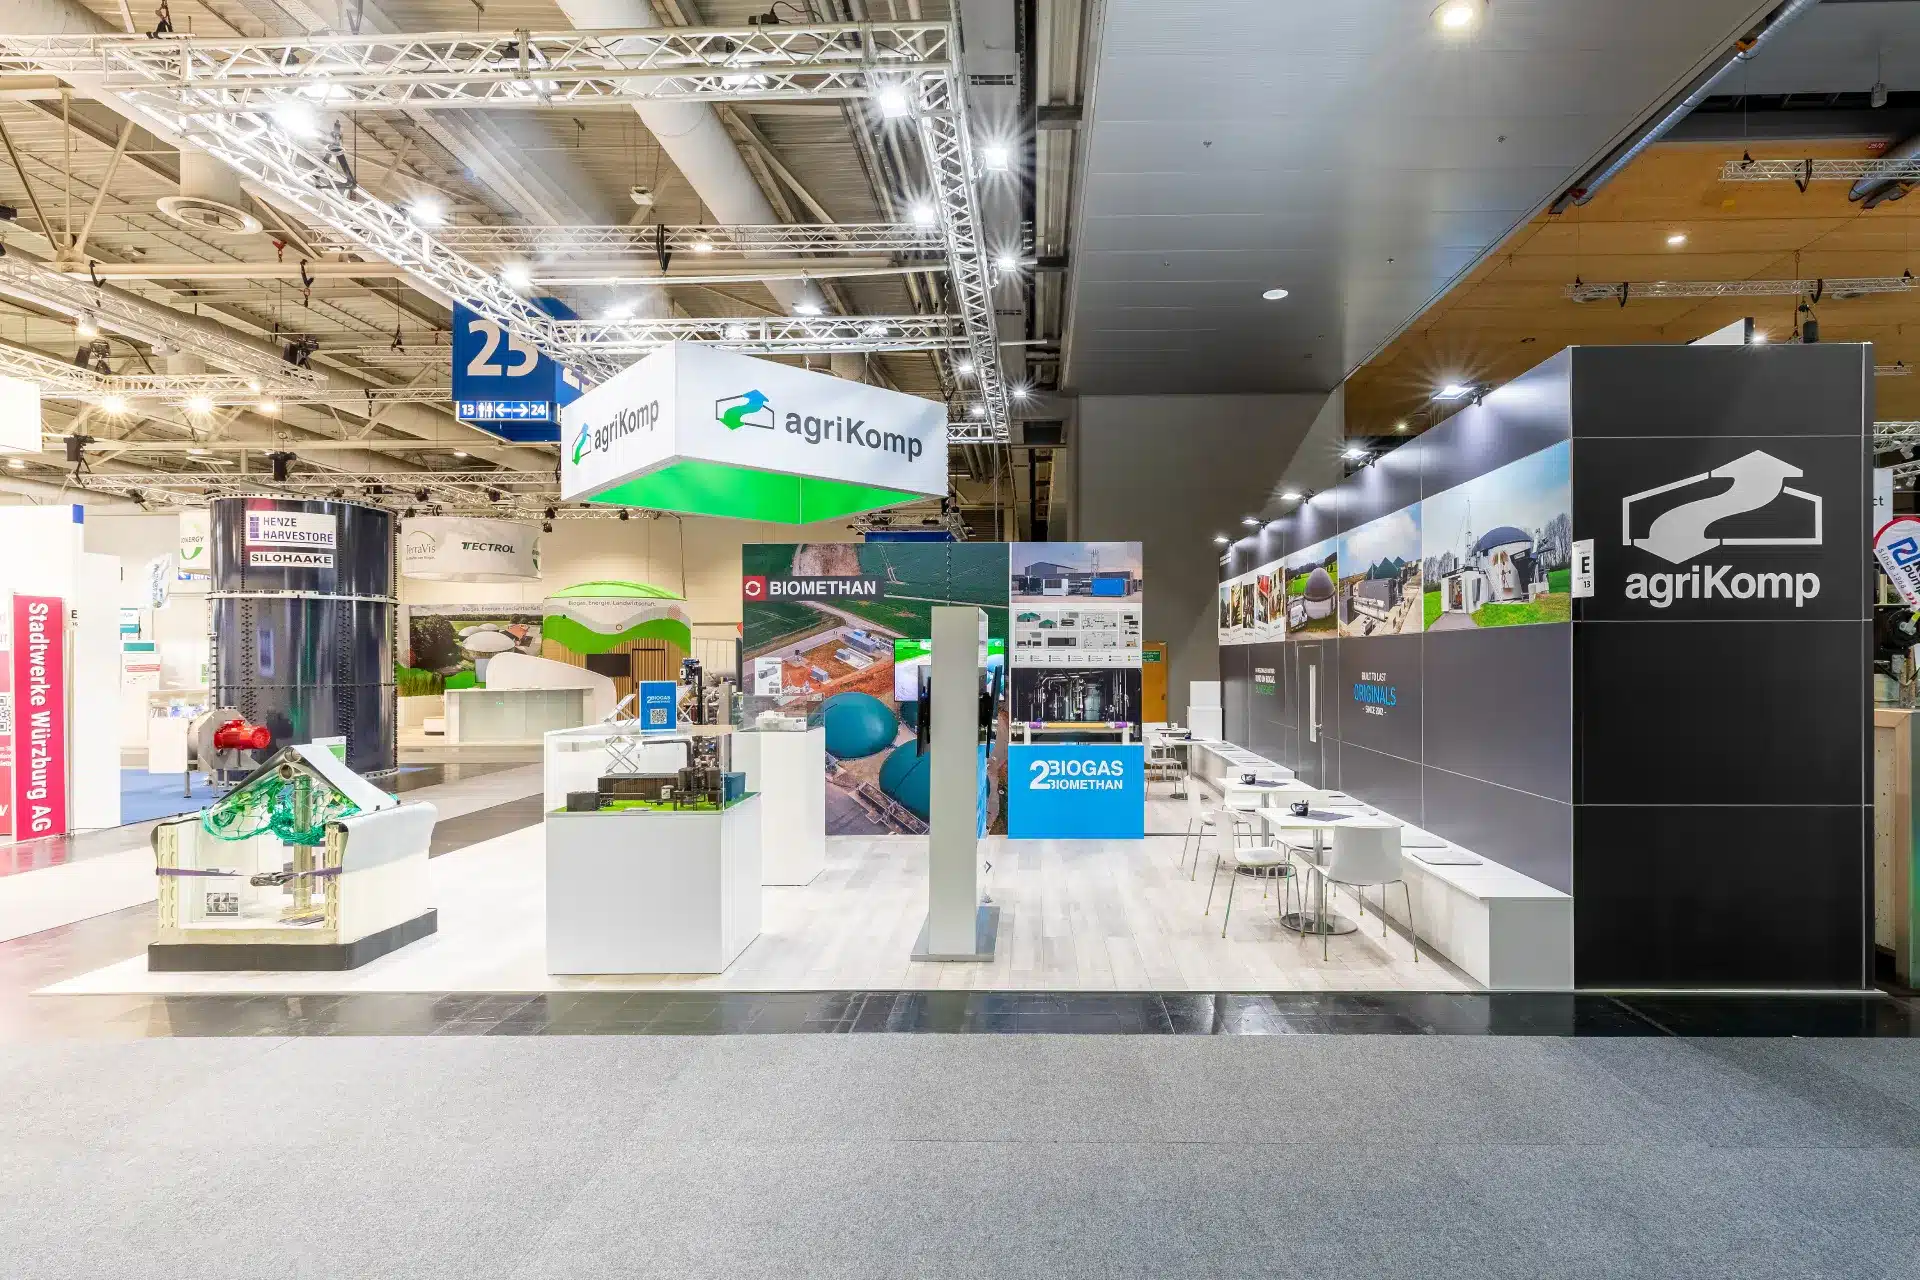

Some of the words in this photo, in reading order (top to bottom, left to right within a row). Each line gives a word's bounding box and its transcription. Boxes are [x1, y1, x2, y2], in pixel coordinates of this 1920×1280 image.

[467, 319, 539, 377] 25
[461, 404, 475, 416] 13
[530, 404, 546, 416] 24
[594, 400, 659, 453] agriKomp
[785, 412, 923, 463] agriKomp
[263, 516, 297, 527] HENZE
[263, 530, 334, 543] HARVESTORE
[406, 543, 436, 555] TerraVis
[461, 541, 516, 554] TECTROL
[251, 553, 332, 564] SILOHAAKE
[1582, 556, 1590, 574] E
[769, 580, 877, 595] BIOMETHAN
[1584, 580, 1591, 588] 13
[1625, 565, 1821, 608] agriKomp
[71, 609, 78, 619] E
[28, 602, 51, 706] Stadtwerke
[1377, 672, 1386, 681] LAST
[1354, 683, 1397, 706] ORIGINALS
[27, 710, 52, 800] Würzburg
[31, 805, 52, 832] AG
